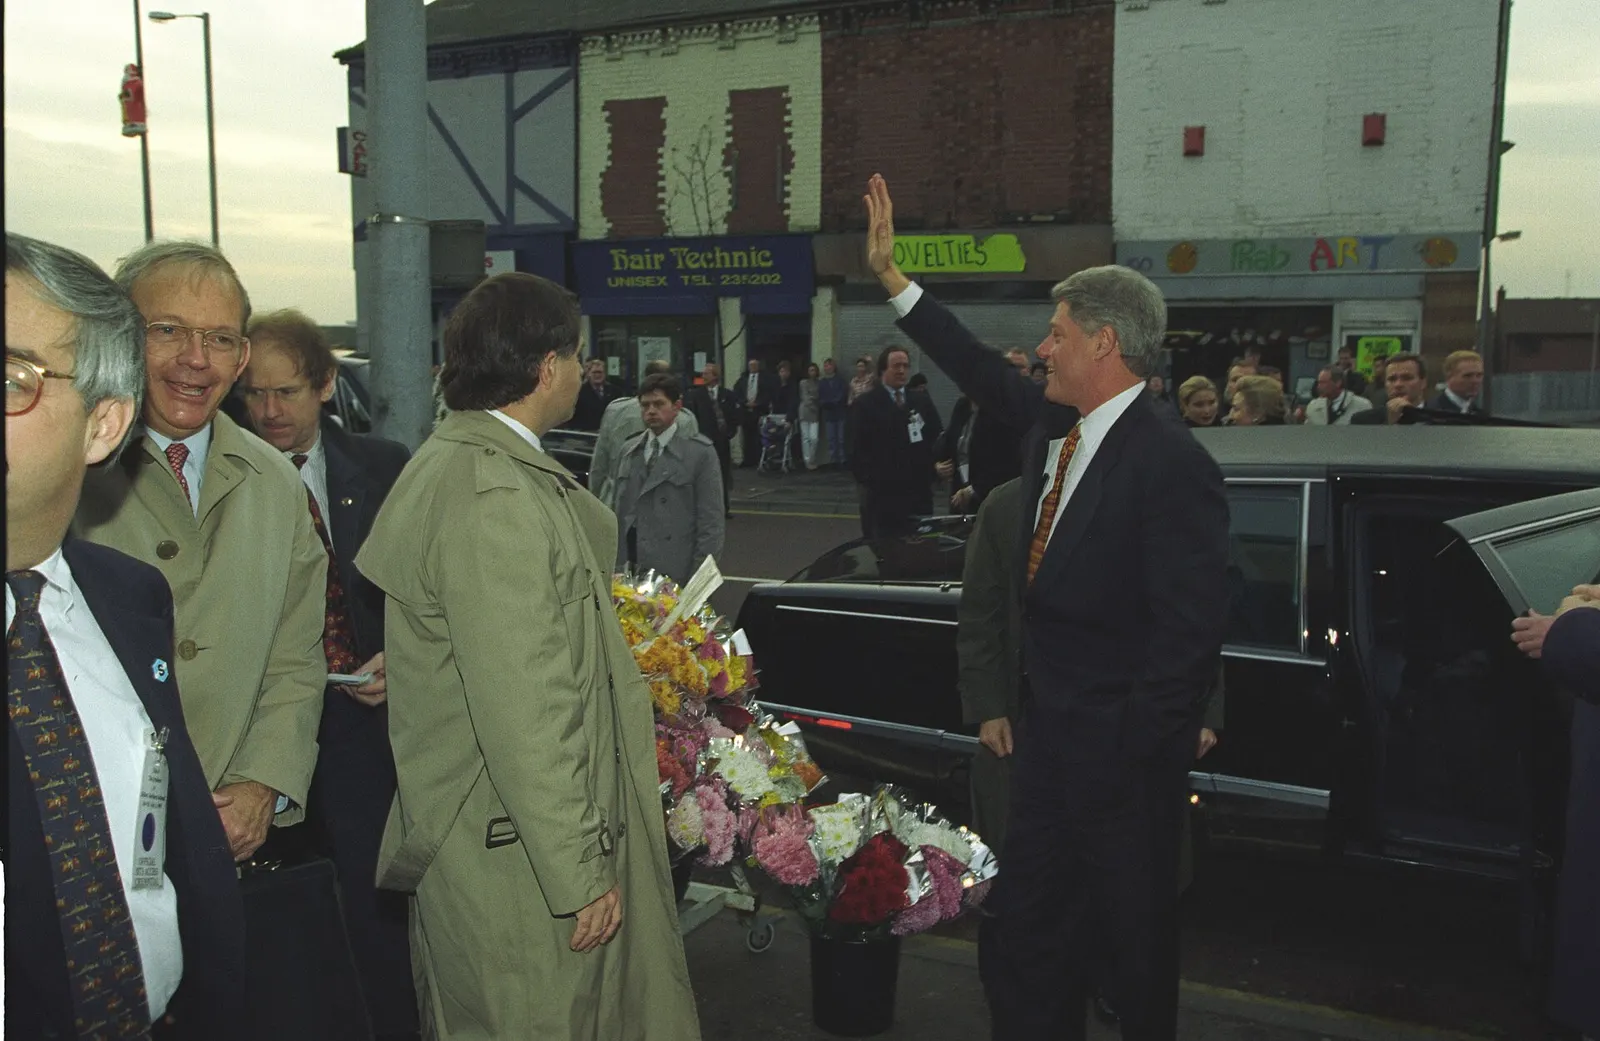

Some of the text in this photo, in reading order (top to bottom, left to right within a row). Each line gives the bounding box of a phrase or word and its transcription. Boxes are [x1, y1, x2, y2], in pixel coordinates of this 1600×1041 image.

[669, 246, 774, 269] Technic
[893, 239, 988, 268] OVELTIES
[1309, 235, 1395, 271] ART
[607, 275, 668, 288] UNISEX
